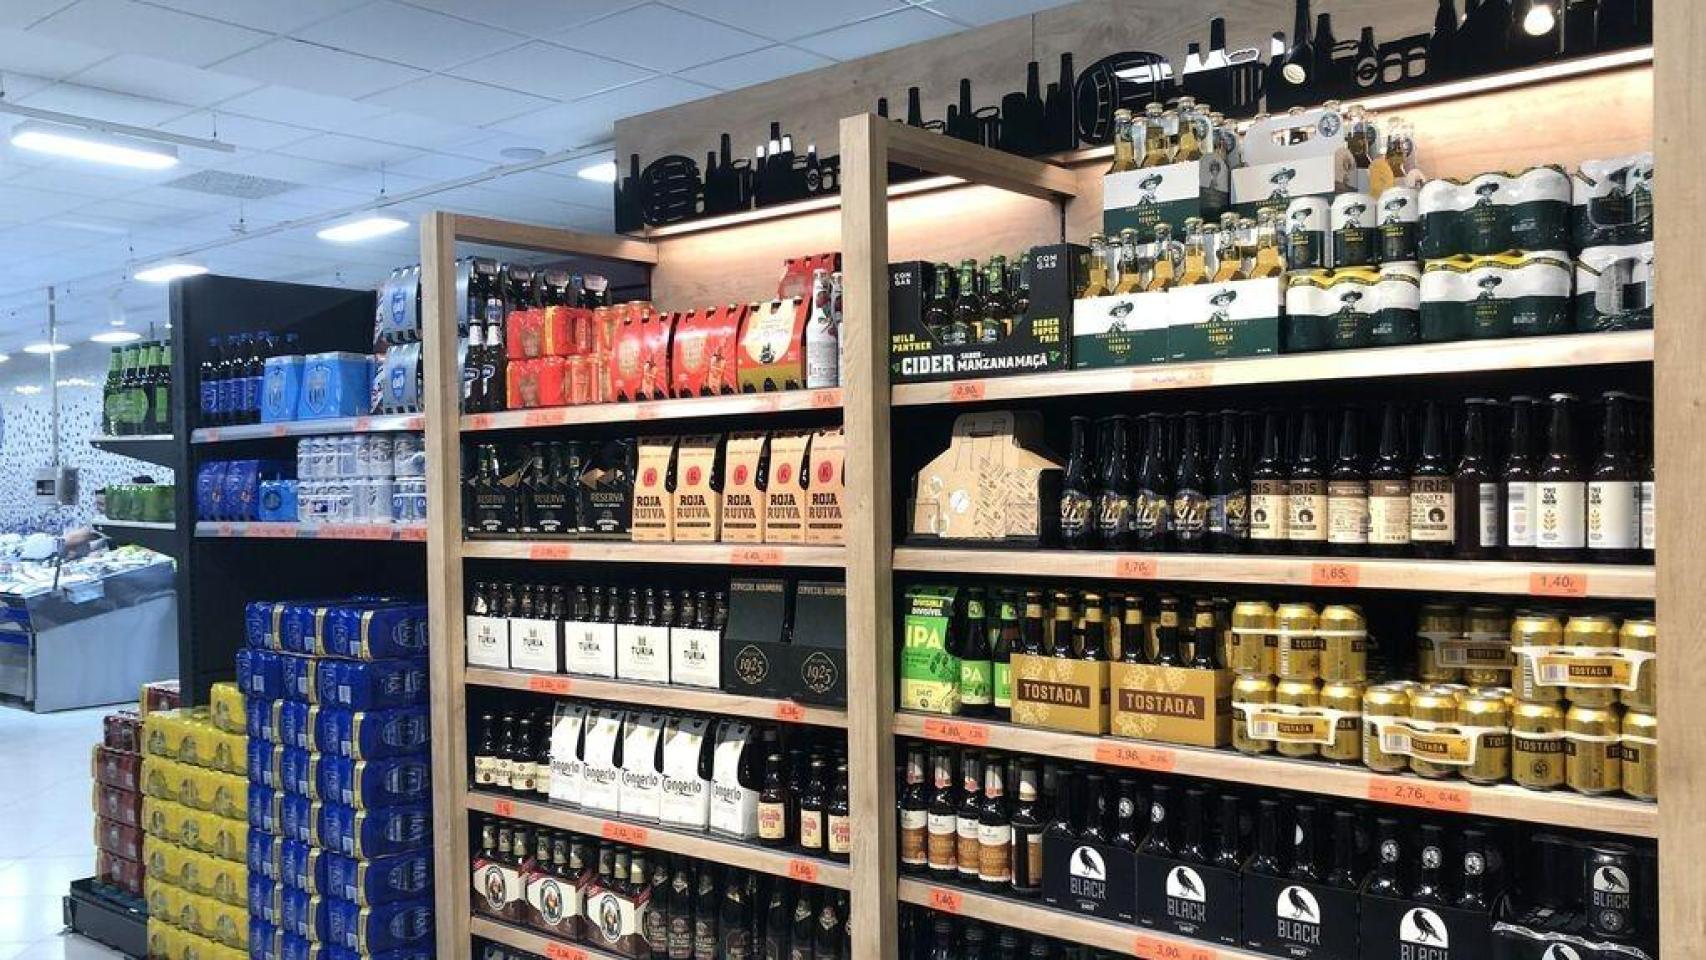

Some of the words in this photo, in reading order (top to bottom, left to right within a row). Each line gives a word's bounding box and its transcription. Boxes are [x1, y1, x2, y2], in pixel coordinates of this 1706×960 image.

[1036, 254, 1057, 262] CON
[1036, 262, 1056, 270] GAS
[892, 334, 915, 342] WILD
[892, 341, 932, 352] PANTHER
[902, 354, 955, 375] CIDER
[590, 492, 625, 503] RESERVA
[637, 496, 661, 507] ROJA
[680, 495, 706, 506] ROJA
[727, 494, 751, 505] ROJA
[770, 493, 796, 505] ROJA
[812, 493, 838, 505] ROJA
[633, 508, 665, 519] RUIVA
[676, 507, 710, 518] RUIVA
[724, 507, 756, 518] RUIVA
[767, 507, 801, 518] RUIVA
[808, 506, 842, 518] RUIVA
[906, 625, 942, 649] IPA
[808, 665, 832, 683] 1925
[962, 667, 983, 682] PA
[1570, 666, 1608, 675] TOSTADA
[1023, 683, 1083, 705] TOSTADA
[1126, 693, 1196, 715] TOSTADA
[662, 773, 702, 796] Tongerlo
[1070, 877, 1106, 899] BLACK
[1593, 891, 1630, 909] BLACK
[1167, 898, 1206, 922] BLACK
[1277, 920, 1320, 945] BLACK
